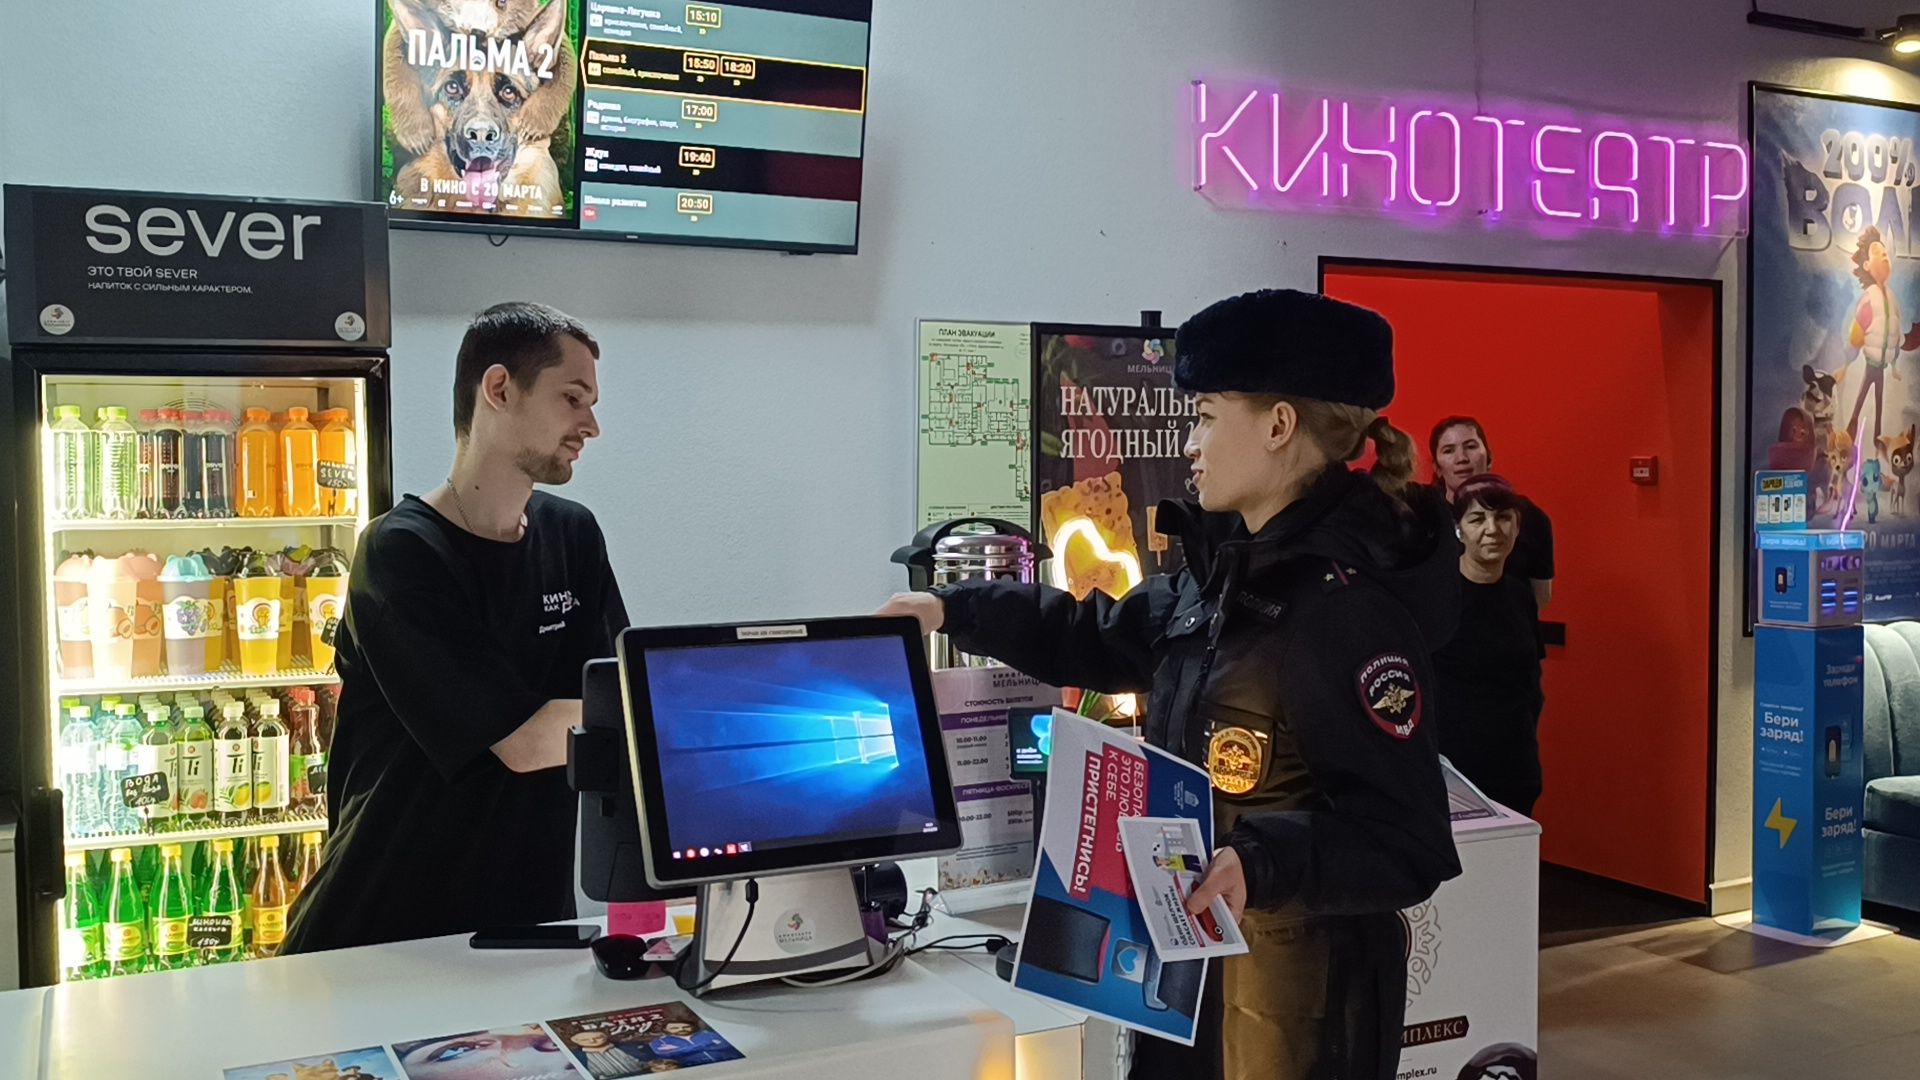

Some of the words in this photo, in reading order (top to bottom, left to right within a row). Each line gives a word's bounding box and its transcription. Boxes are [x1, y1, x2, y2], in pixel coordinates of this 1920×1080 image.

[407, 28, 532, 76] ПАЛЬМА
[537, 42, 553, 79] 2
[685, 103, 714, 116] 17:00
[683, 151, 712, 164] 19:40
[1198, 81, 1750, 229] КИНОТЕАТР
[1822, 128, 1915, 187] 200%
[389, 190, 405, 205] 6+
[420, 178, 429, 192] В
[433, 179, 466, 195] КИНО
[471, 184, 480, 196] С
[503, 185, 542, 200] МАРТА
[681, 197, 710, 210] 20:50
[85, 204, 322, 261] sever
[87, 265, 114, 277] ЭТО
[117, 266, 152, 279] ТВОЙ
[156, 268, 198, 280] SEVER
[88, 282, 133, 291] НАПИТОК
[142, 284, 191, 293] СИЛЬНЫМ
[938, 328, 957, 338] ПЛАН
[958, 329, 996, 339] ЭВАКУАЦИИ
[1127, 364, 1173, 375] МЕЛЬНИЦ
[1060, 386, 1198, 417] НАТУРАЛЬН
[1060, 421, 1181, 464] ЯГОДНЫЙ
[1360, 655, 1409, 684] ПОЛИЦИЯ
[993, 678, 1040, 689] МЕЛЬНИЦ
[1369, 669, 1410, 698] РОССИЯ
[1395, 718, 1416, 737] МВД
[1764, 711, 1800, 730] Бери
[1760, 725, 1804, 744] заряд!
[1107, 750, 1117, 761] К
[1120, 755, 1134, 783] ЭТО
[1104, 764, 1117, 801] СЕБЕ
[1131, 760, 1146, 818] БЕЗОПА
[1824, 804, 1853, 823] Бери
[1072, 755, 1101, 894] ПРИСТЕГНИСЬ!
[1821, 818, 1857, 840] заряд!
